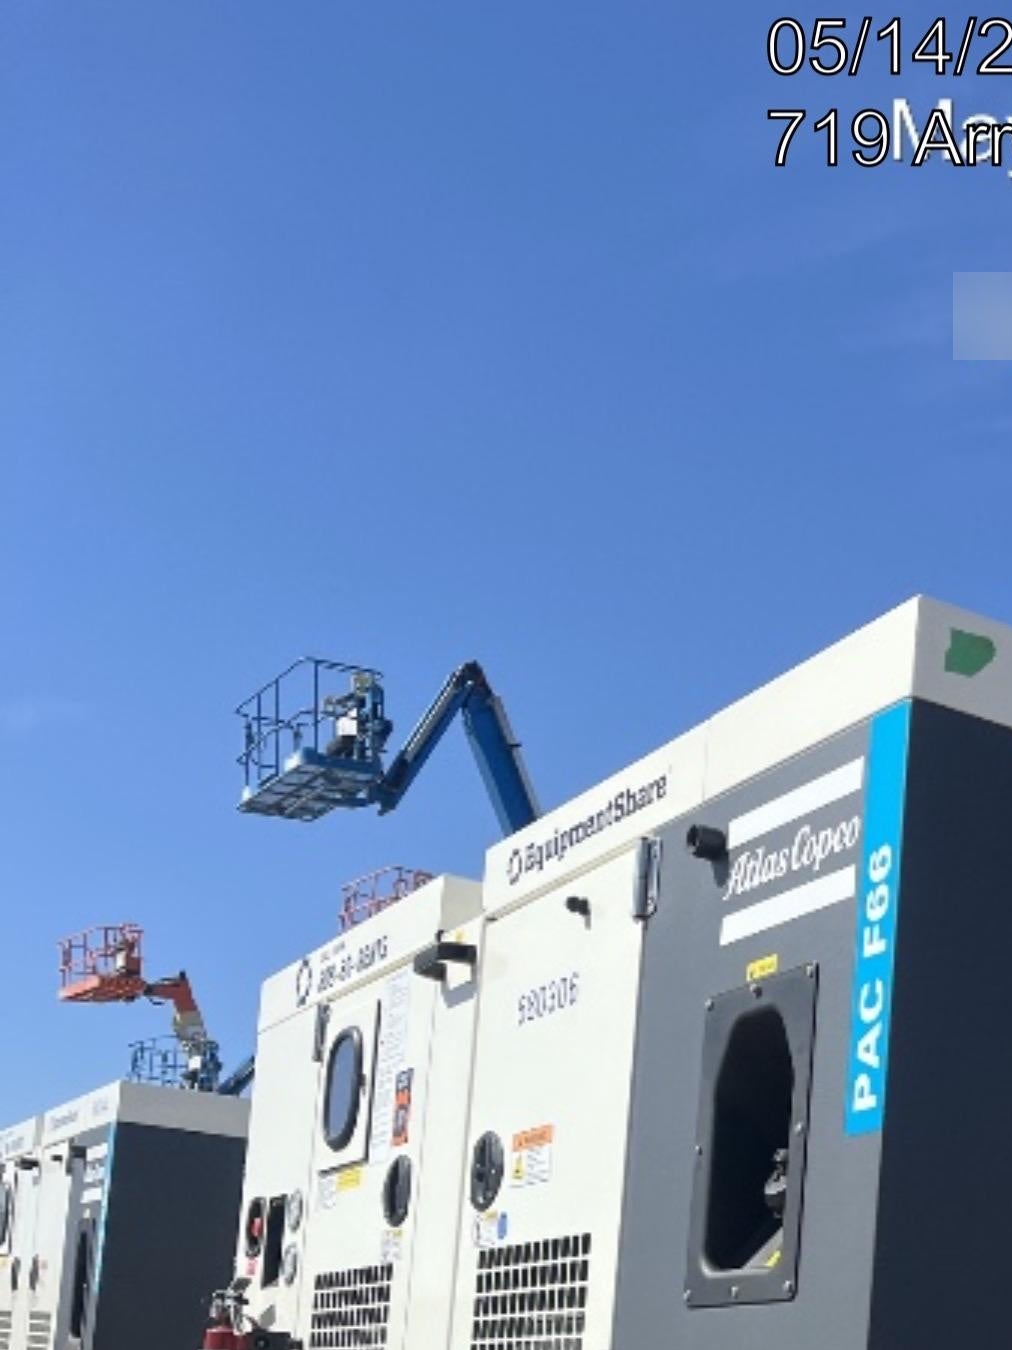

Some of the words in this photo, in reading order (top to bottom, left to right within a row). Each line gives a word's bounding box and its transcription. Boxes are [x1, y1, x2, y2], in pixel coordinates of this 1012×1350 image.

[525, 774, 667, 873] EquipmentShare
[722, 846, 789, 901] Atlas
[791, 816, 861, 873] Copco
[863, 842, 893, 959] F66
[852, 978, 885, 1114] PAC
